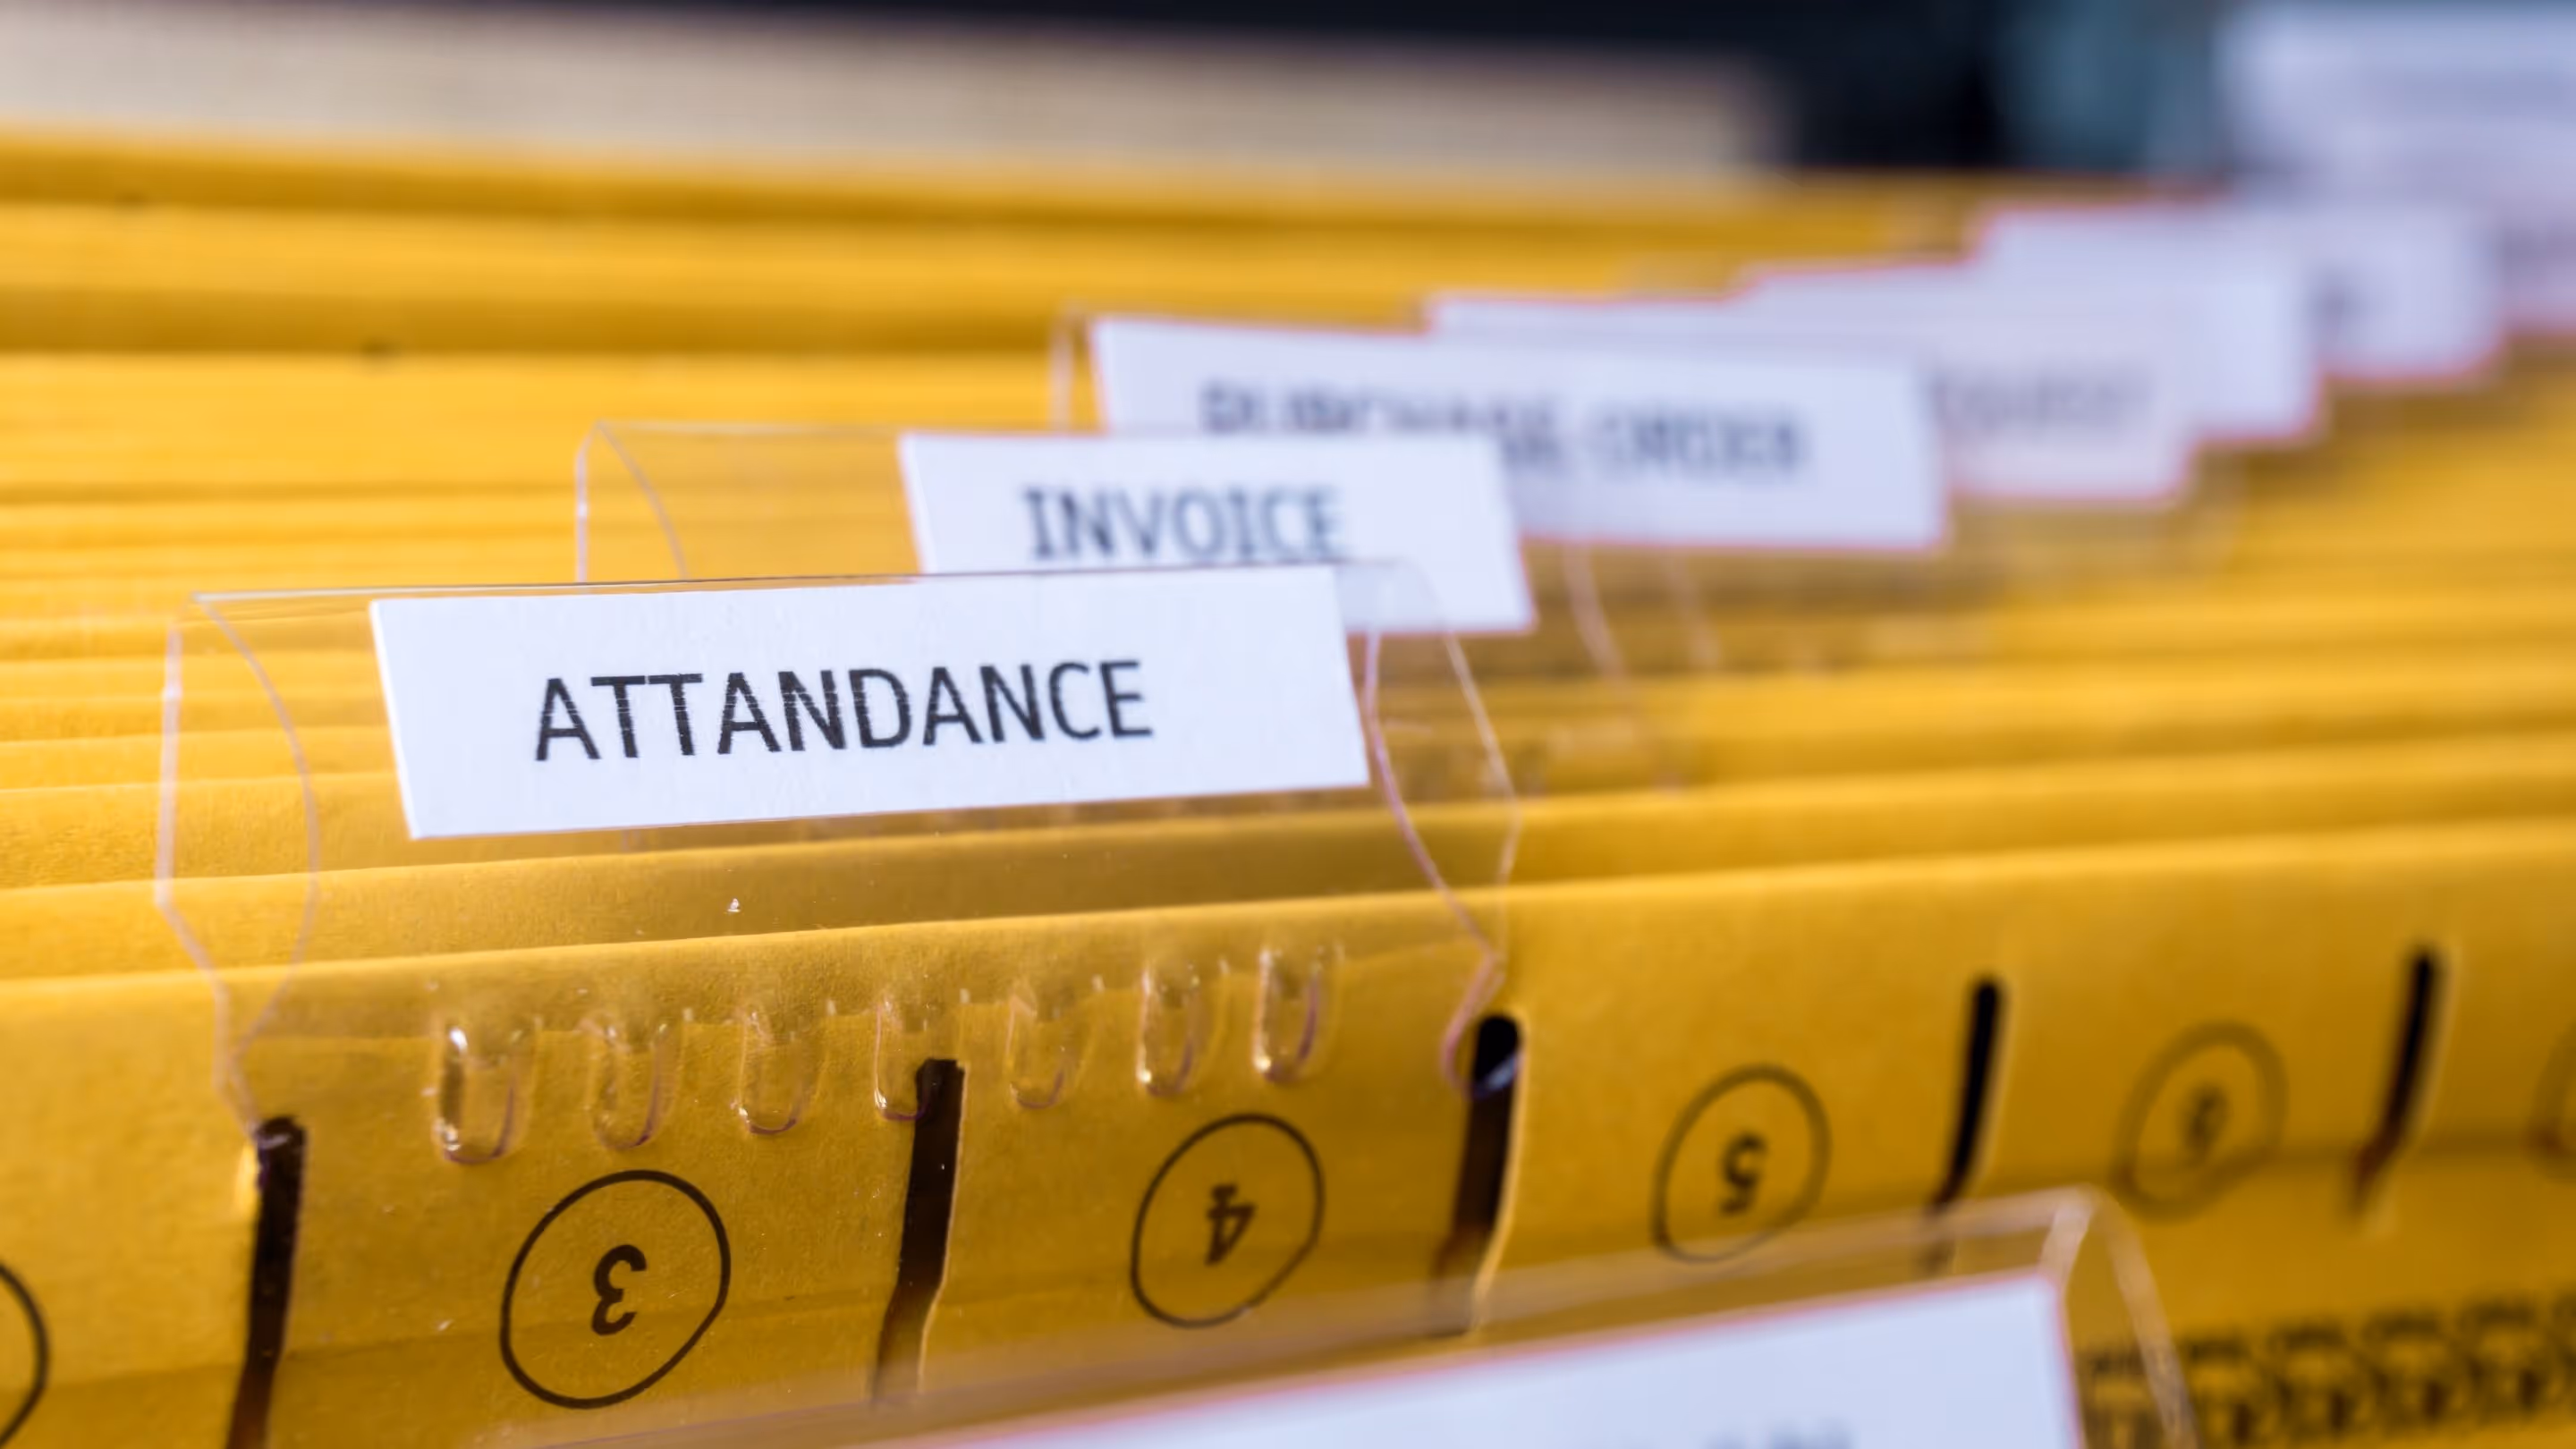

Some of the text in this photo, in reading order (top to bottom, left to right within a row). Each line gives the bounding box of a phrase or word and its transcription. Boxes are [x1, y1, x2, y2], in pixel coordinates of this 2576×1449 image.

[1022, 483, 1345, 561] INVOICE
[535, 659, 1153, 762] ATTANDANCE
[1719, 1131, 1768, 1216] 5
[1204, 1182, 1257, 1267] 4
[590, 1243, 648, 1336] 3
